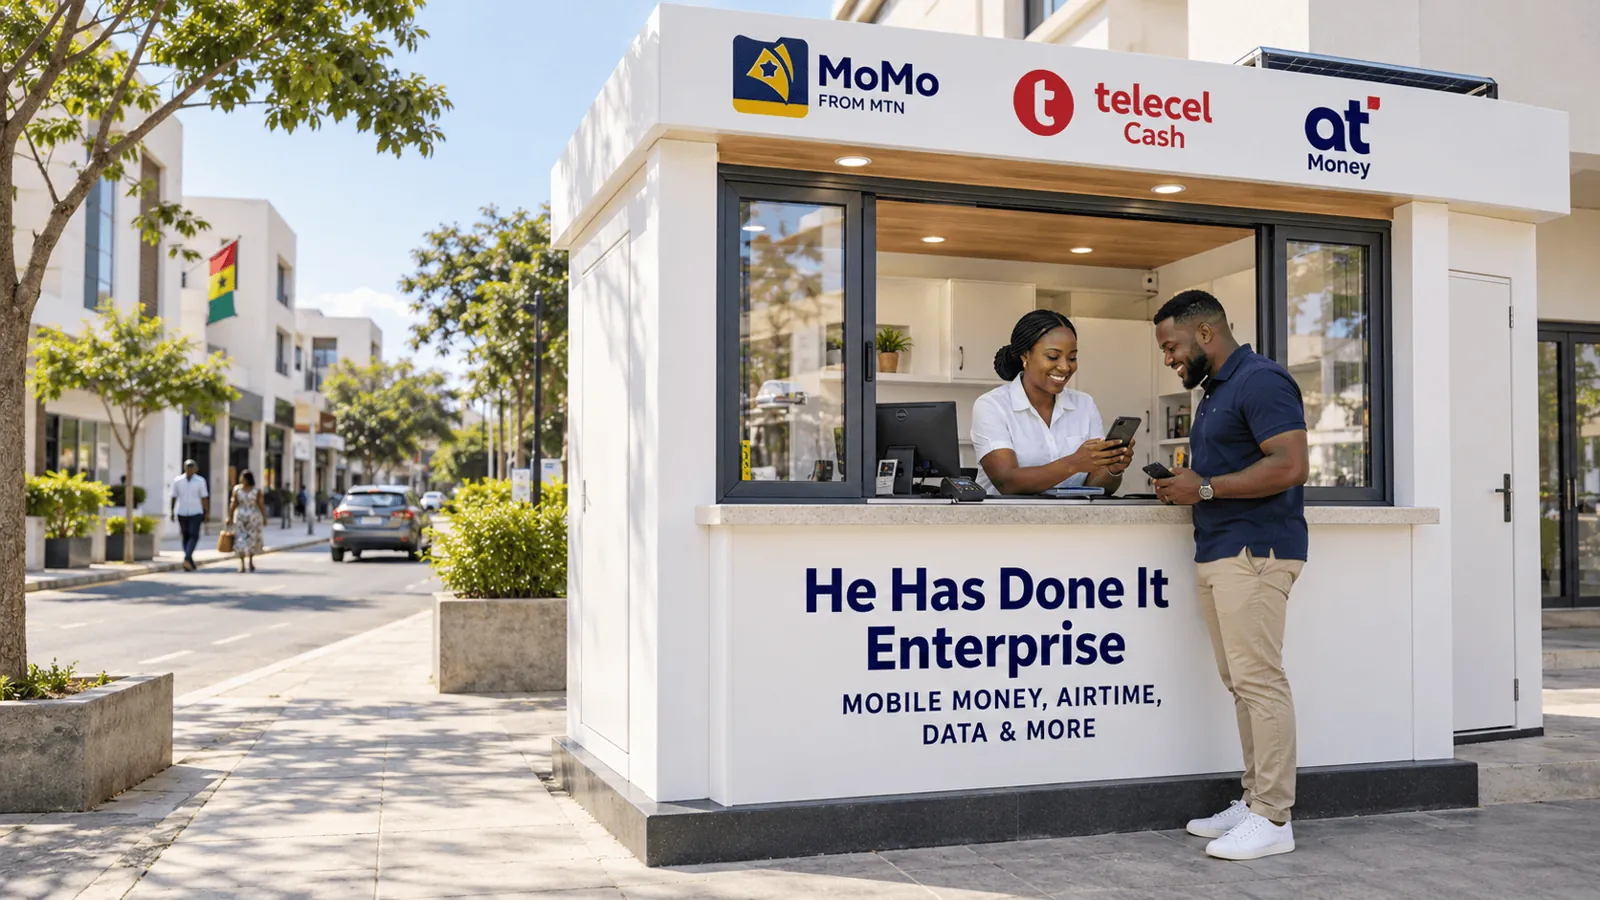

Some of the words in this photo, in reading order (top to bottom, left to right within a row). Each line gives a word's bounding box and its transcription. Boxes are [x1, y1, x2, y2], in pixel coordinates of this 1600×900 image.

[818, 54, 940, 97] MoMo
[818, 93, 865, 111] FROM
[870, 98, 905, 115] MTN
[1093, 82, 1213, 124] telecel
[1123, 121, 1185, 149] Cash
[1304, 99, 1371, 155] at
[1307, 152, 1371, 180] Money
[805, 567, 877, 613] He
[891, 567, 986, 612] Has
[999, 567, 1125, 611] Done
[1137, 566, 1170, 609] It
[867, 619, 1126, 679] Enterprise
[842, 690, 942, 714] MOBILE
[952, 686, 1048, 712] MONEY,
[1056, 684, 1162, 708] AIRTIME,
[922, 722, 988, 745] DATA
[999, 720, 1017, 742] &
[1026, 717, 1096, 741] MORE
